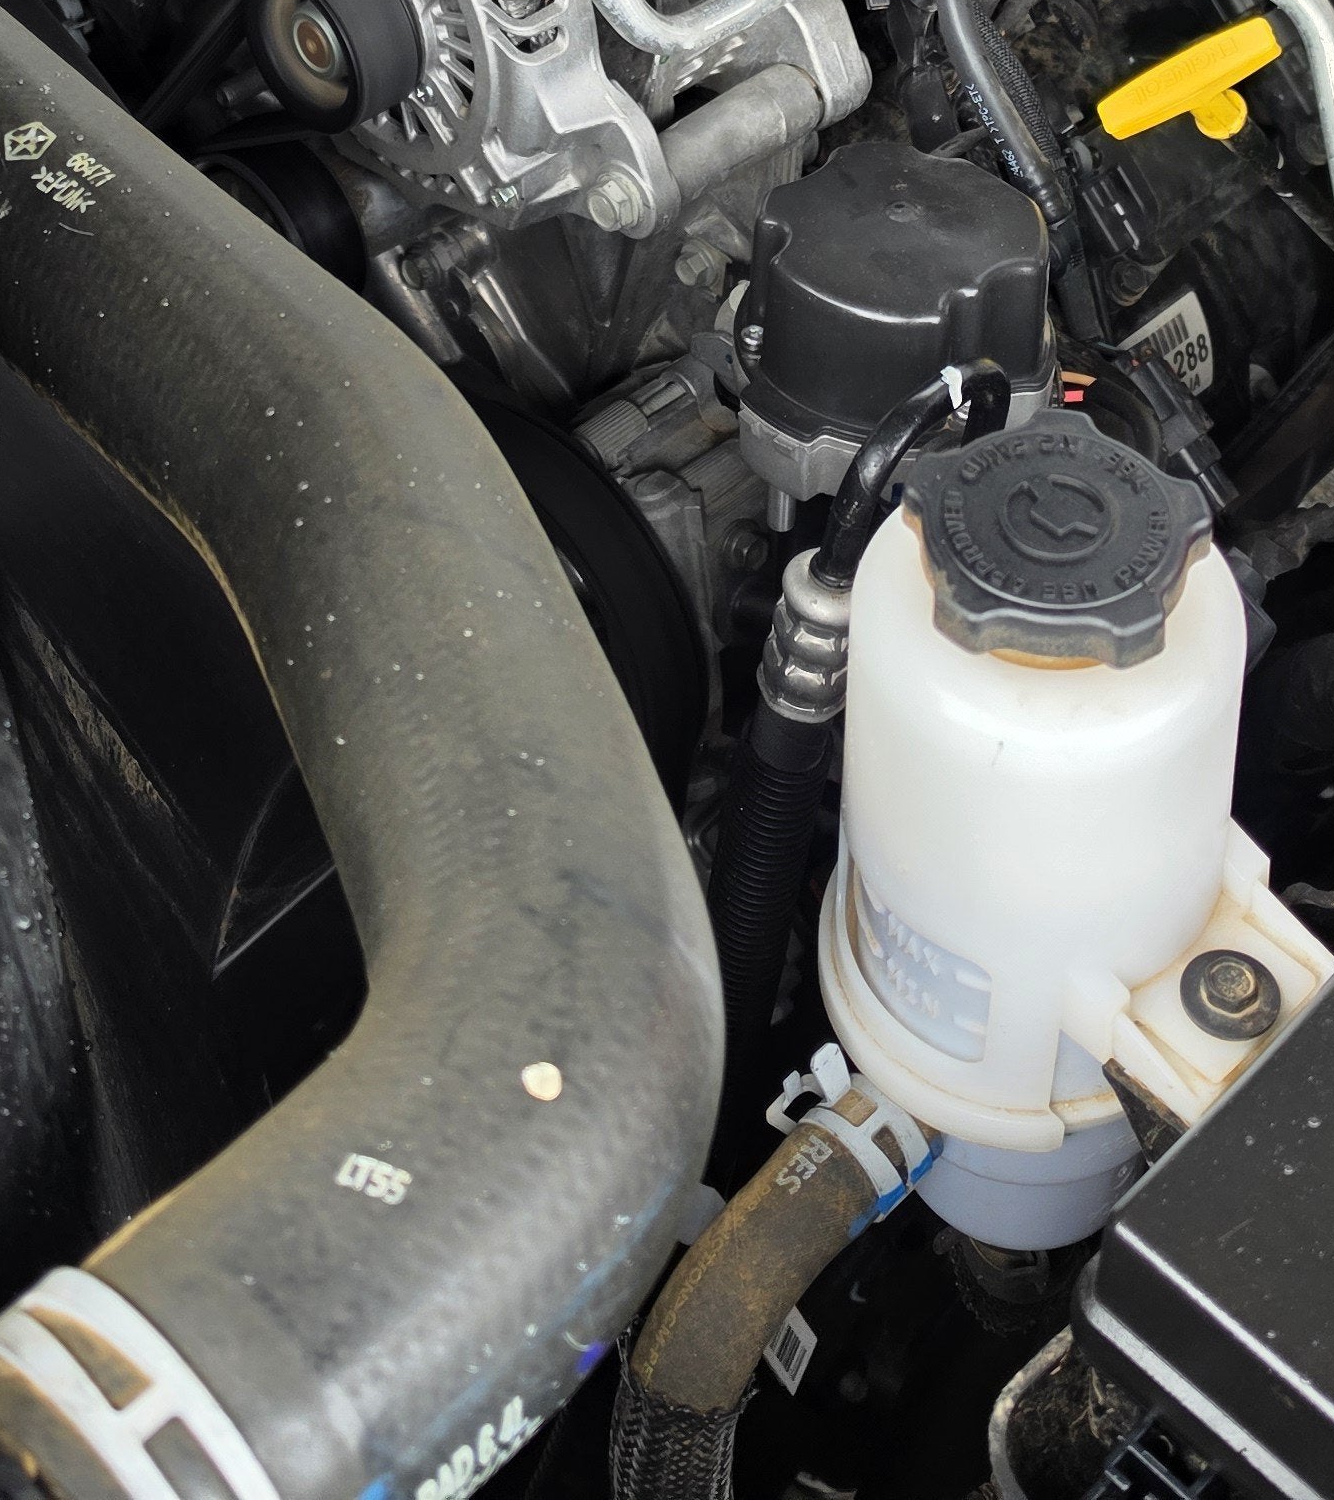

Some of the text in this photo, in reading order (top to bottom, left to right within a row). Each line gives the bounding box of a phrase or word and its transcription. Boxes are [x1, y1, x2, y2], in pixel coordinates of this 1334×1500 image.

[1127, 36, 1238, 106] ENGINE OIL
[1173, 333, 1209, 378] 288
[943, 489, 1099, 600] USE APPROVED
[1114, 509, 1168, 588] POWER
[887, 912, 940, 977] MAX
[885, 956, 941, 1020] MIN
[775, 1133, 834, 1196] RES
